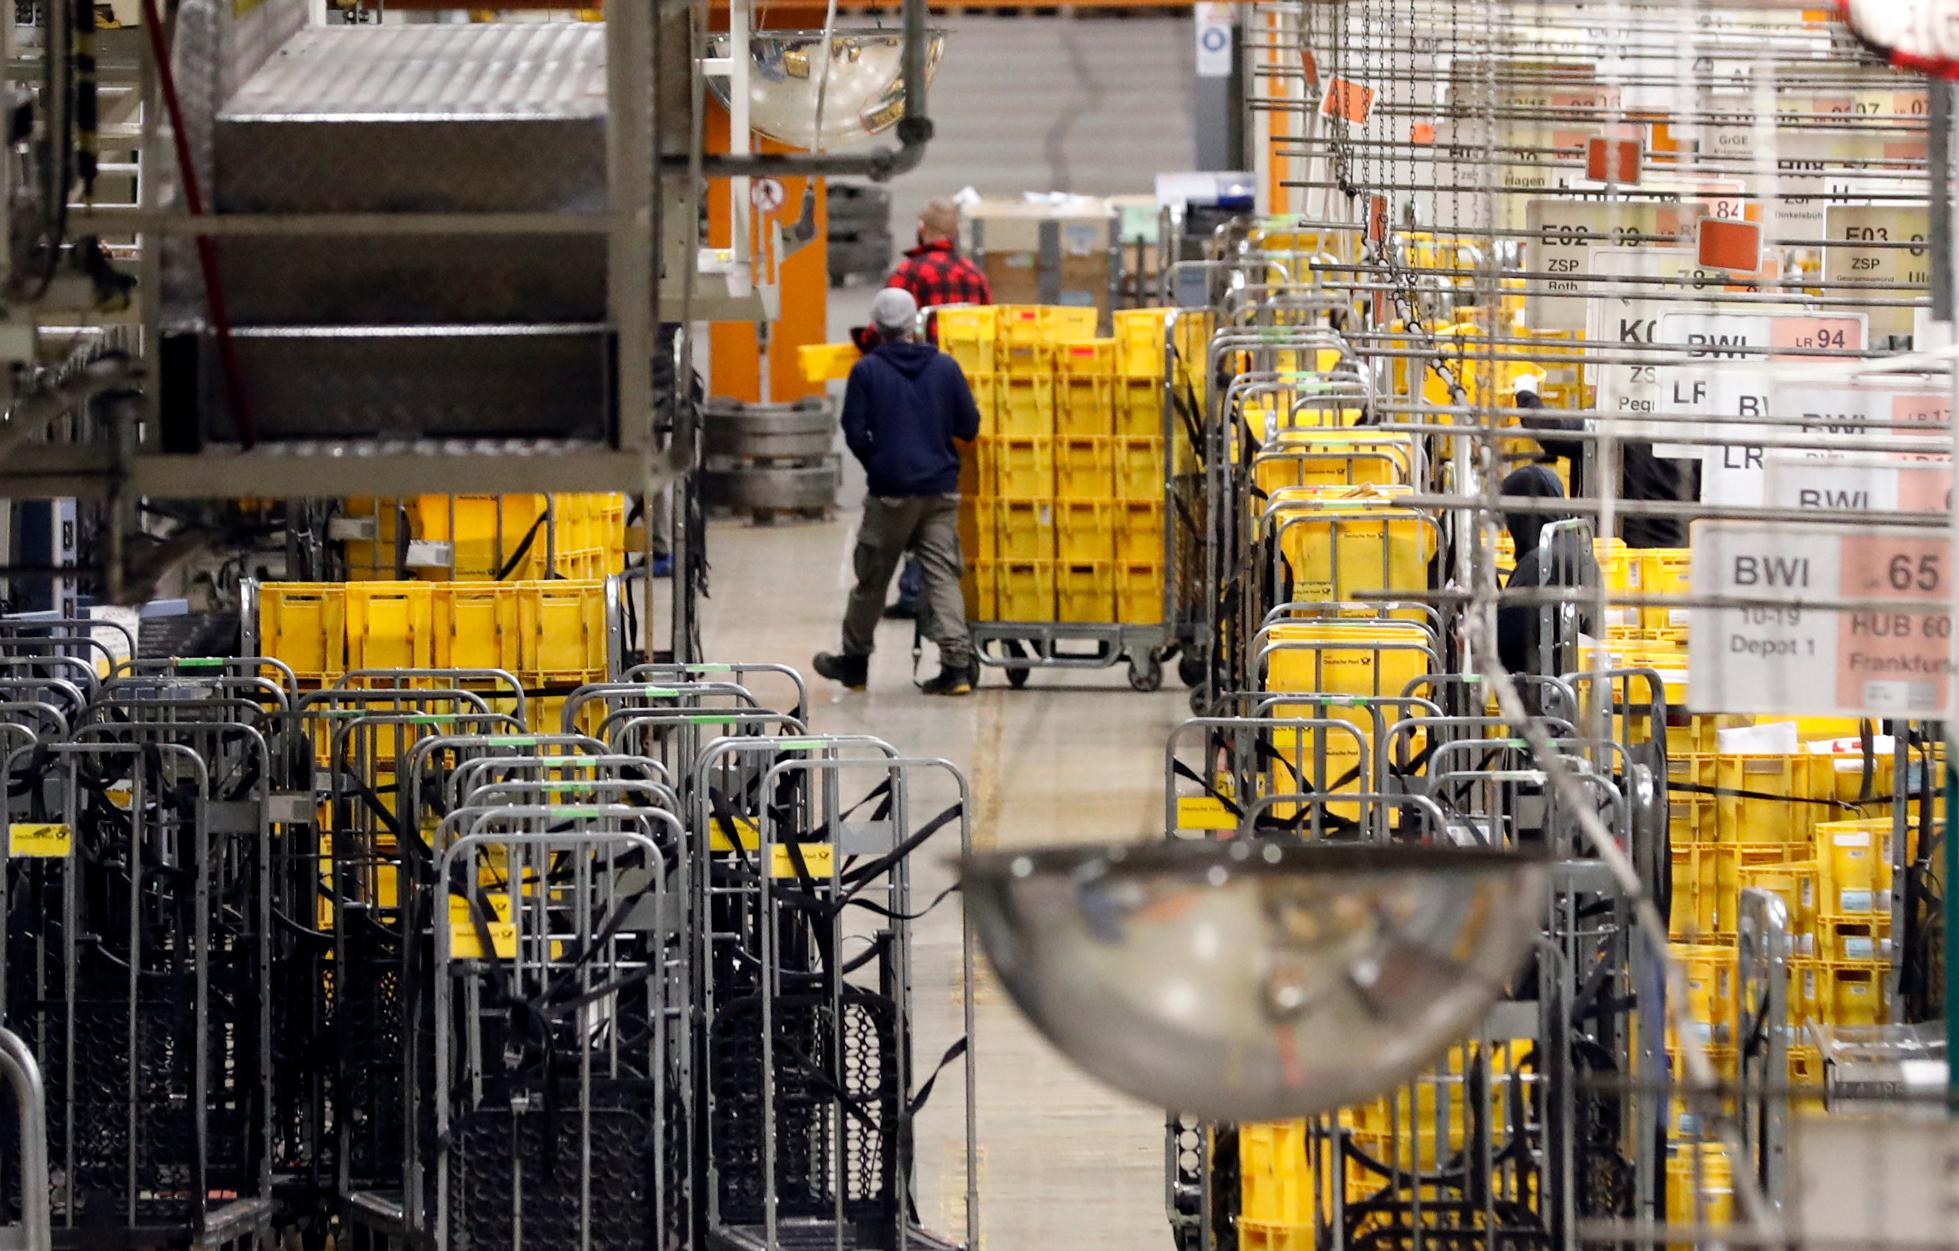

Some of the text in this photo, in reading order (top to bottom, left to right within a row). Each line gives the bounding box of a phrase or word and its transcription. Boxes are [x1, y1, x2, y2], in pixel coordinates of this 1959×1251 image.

[1505, 175, 1545, 187] Hagen
[1542, 224, 1588, 246] E02
[1548, 259, 1579, 272] ZSP
[1851, 258, 1880, 270] ZSP
[1688, 329, 1845, 359] BWI LR 94
[1734, 555, 1939, 591] BWI 65
[1741, 607, 1802, 627] 10-19
[1852, 613, 1911, 636] HUB
[1731, 634, 1815, 659] Depot 1
